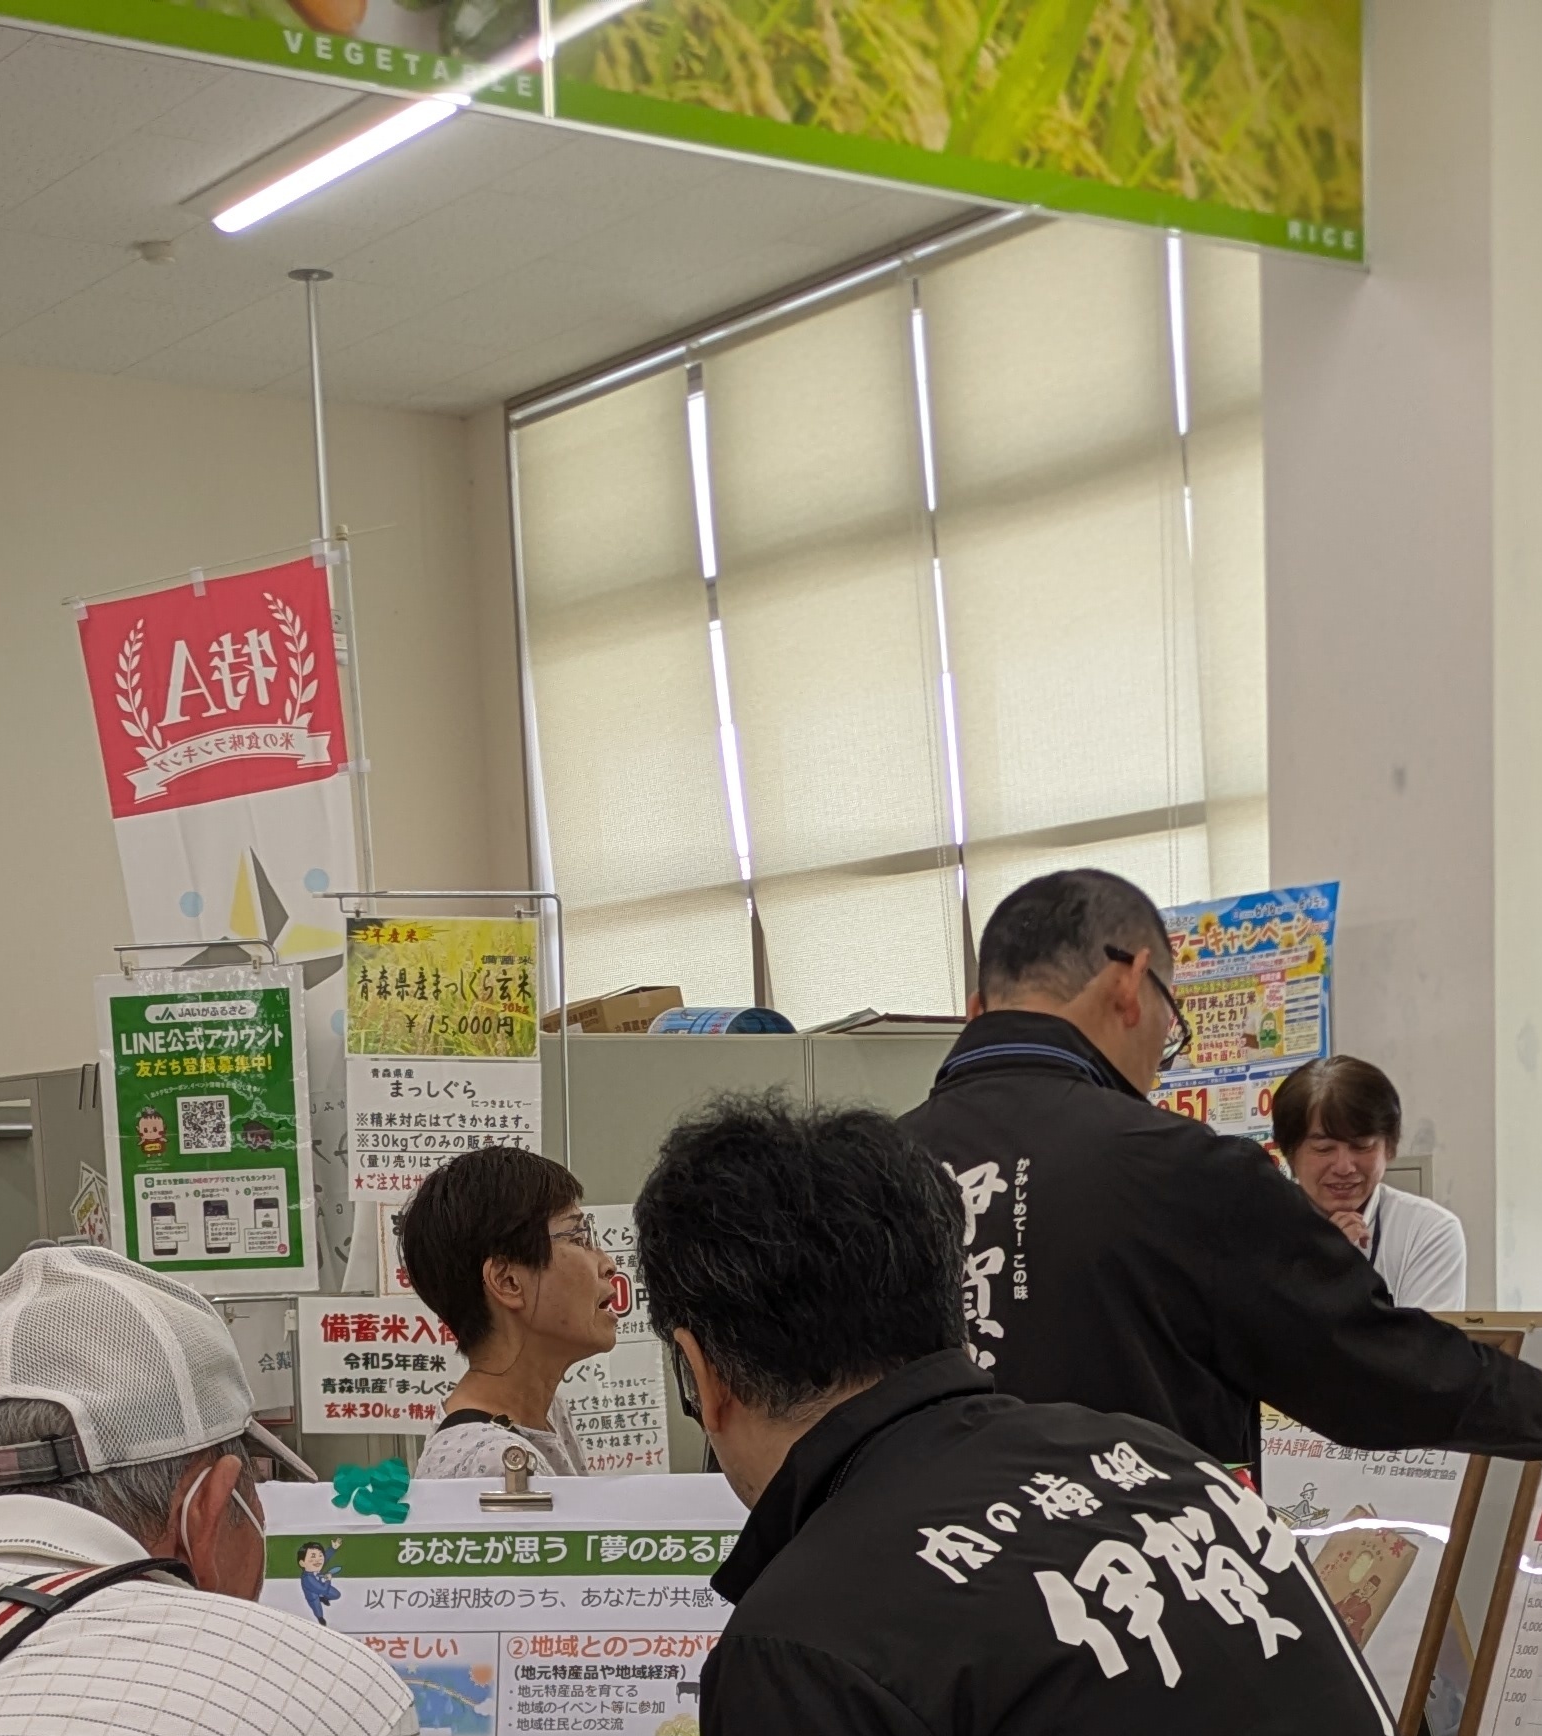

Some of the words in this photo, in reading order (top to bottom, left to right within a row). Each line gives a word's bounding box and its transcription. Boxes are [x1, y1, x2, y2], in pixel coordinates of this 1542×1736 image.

[1287, 220, 1356, 250] RICE
[500, 1002, 530, 1015] 30kg
[121, 1023, 285, 1056] LINE公式アカウント
[371, 1068, 415, 1079] 青森県産
[389, 1080, 477, 1100] まっしぐら
[343, 1352, 447, 1372] 令和5年産米
[575, 1411, 658, 1431] みの販売です。
[514, 1665, 687, 1682] (地元特産品や地域経済)
